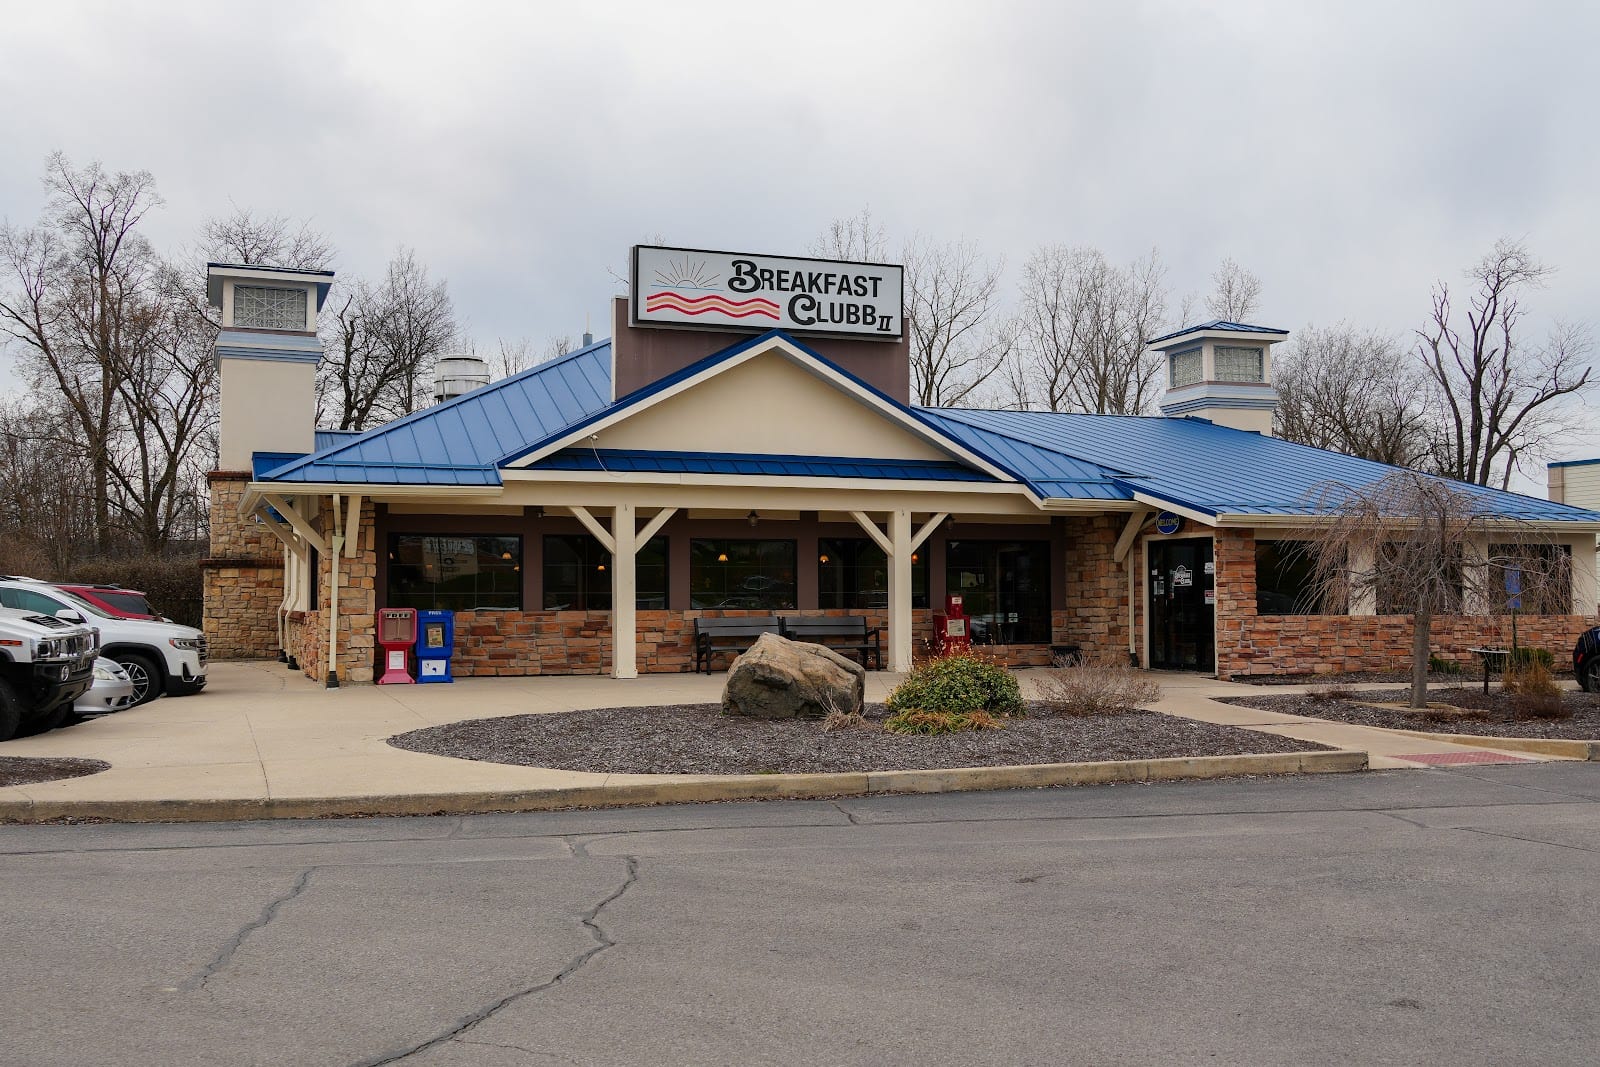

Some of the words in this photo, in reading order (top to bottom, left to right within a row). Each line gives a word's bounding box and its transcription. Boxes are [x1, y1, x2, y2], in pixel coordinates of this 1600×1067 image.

[727, 259, 882, 297] BREAKFAST
[787, 294, 876, 326] CLUBB
[1157, 517, 1178, 526] WELCOME
